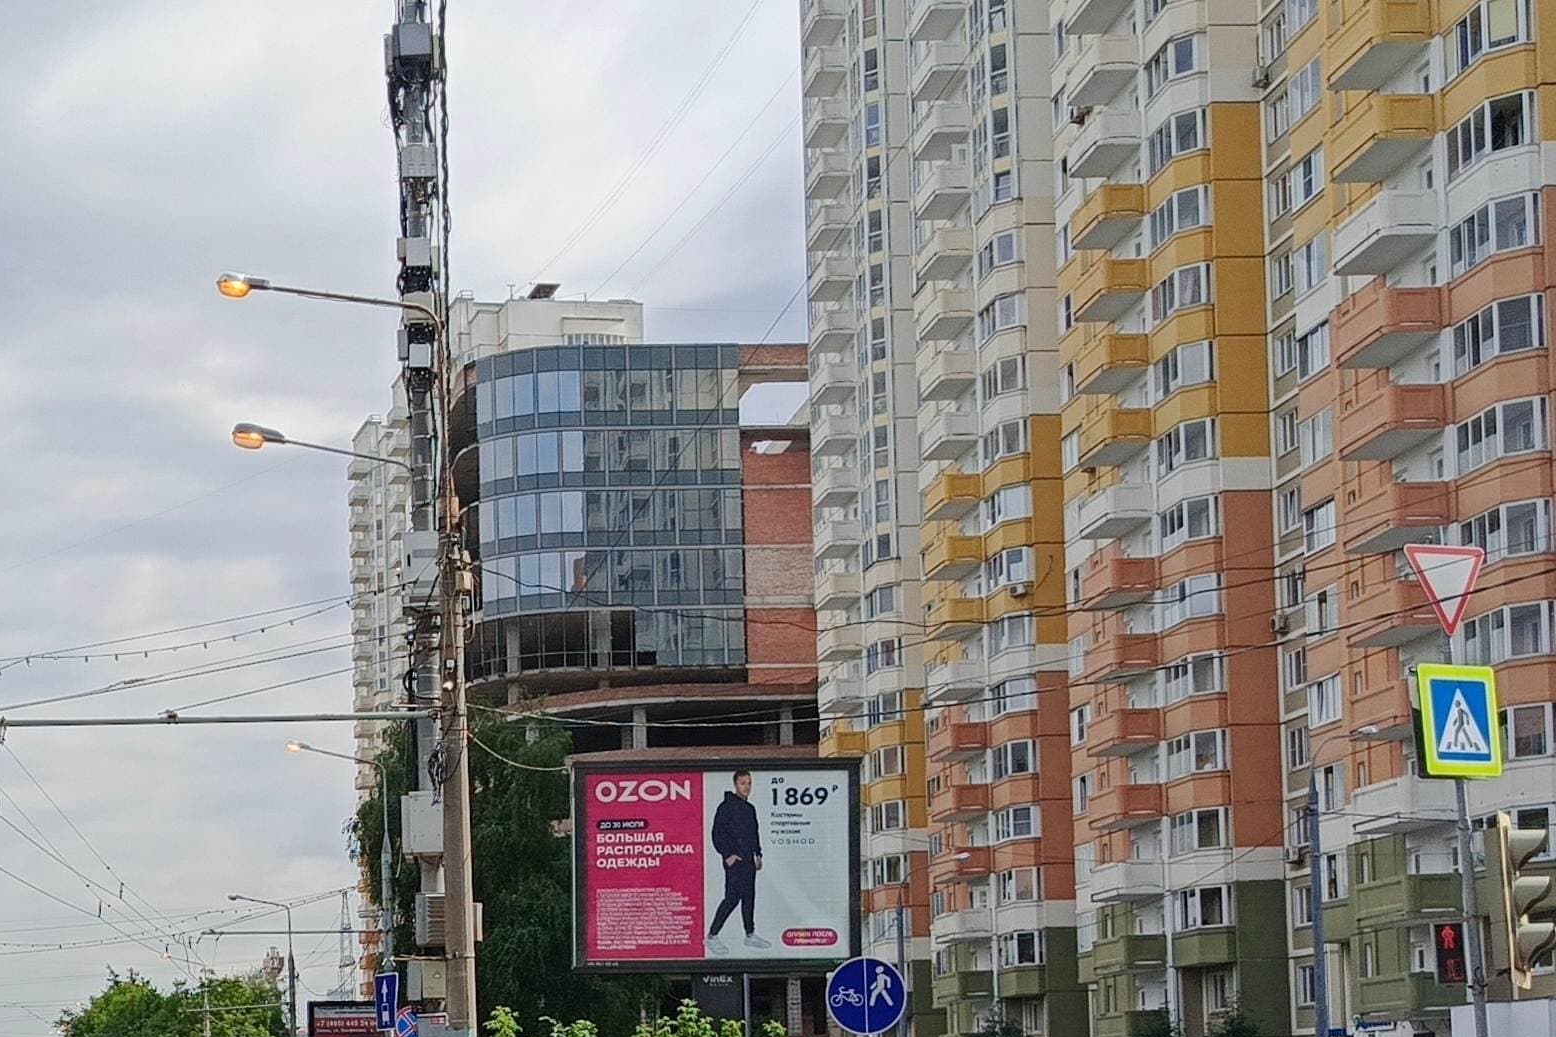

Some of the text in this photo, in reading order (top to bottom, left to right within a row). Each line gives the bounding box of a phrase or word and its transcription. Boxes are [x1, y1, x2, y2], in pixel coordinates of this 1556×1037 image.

[595, 780, 691, 803] OZON
[596, 832, 665, 843] БОЛЬШАЯ
[596, 844, 695, 857] РАСПРОДАЖА
[596, 857, 660, 869] ОДЕЖДЫ
